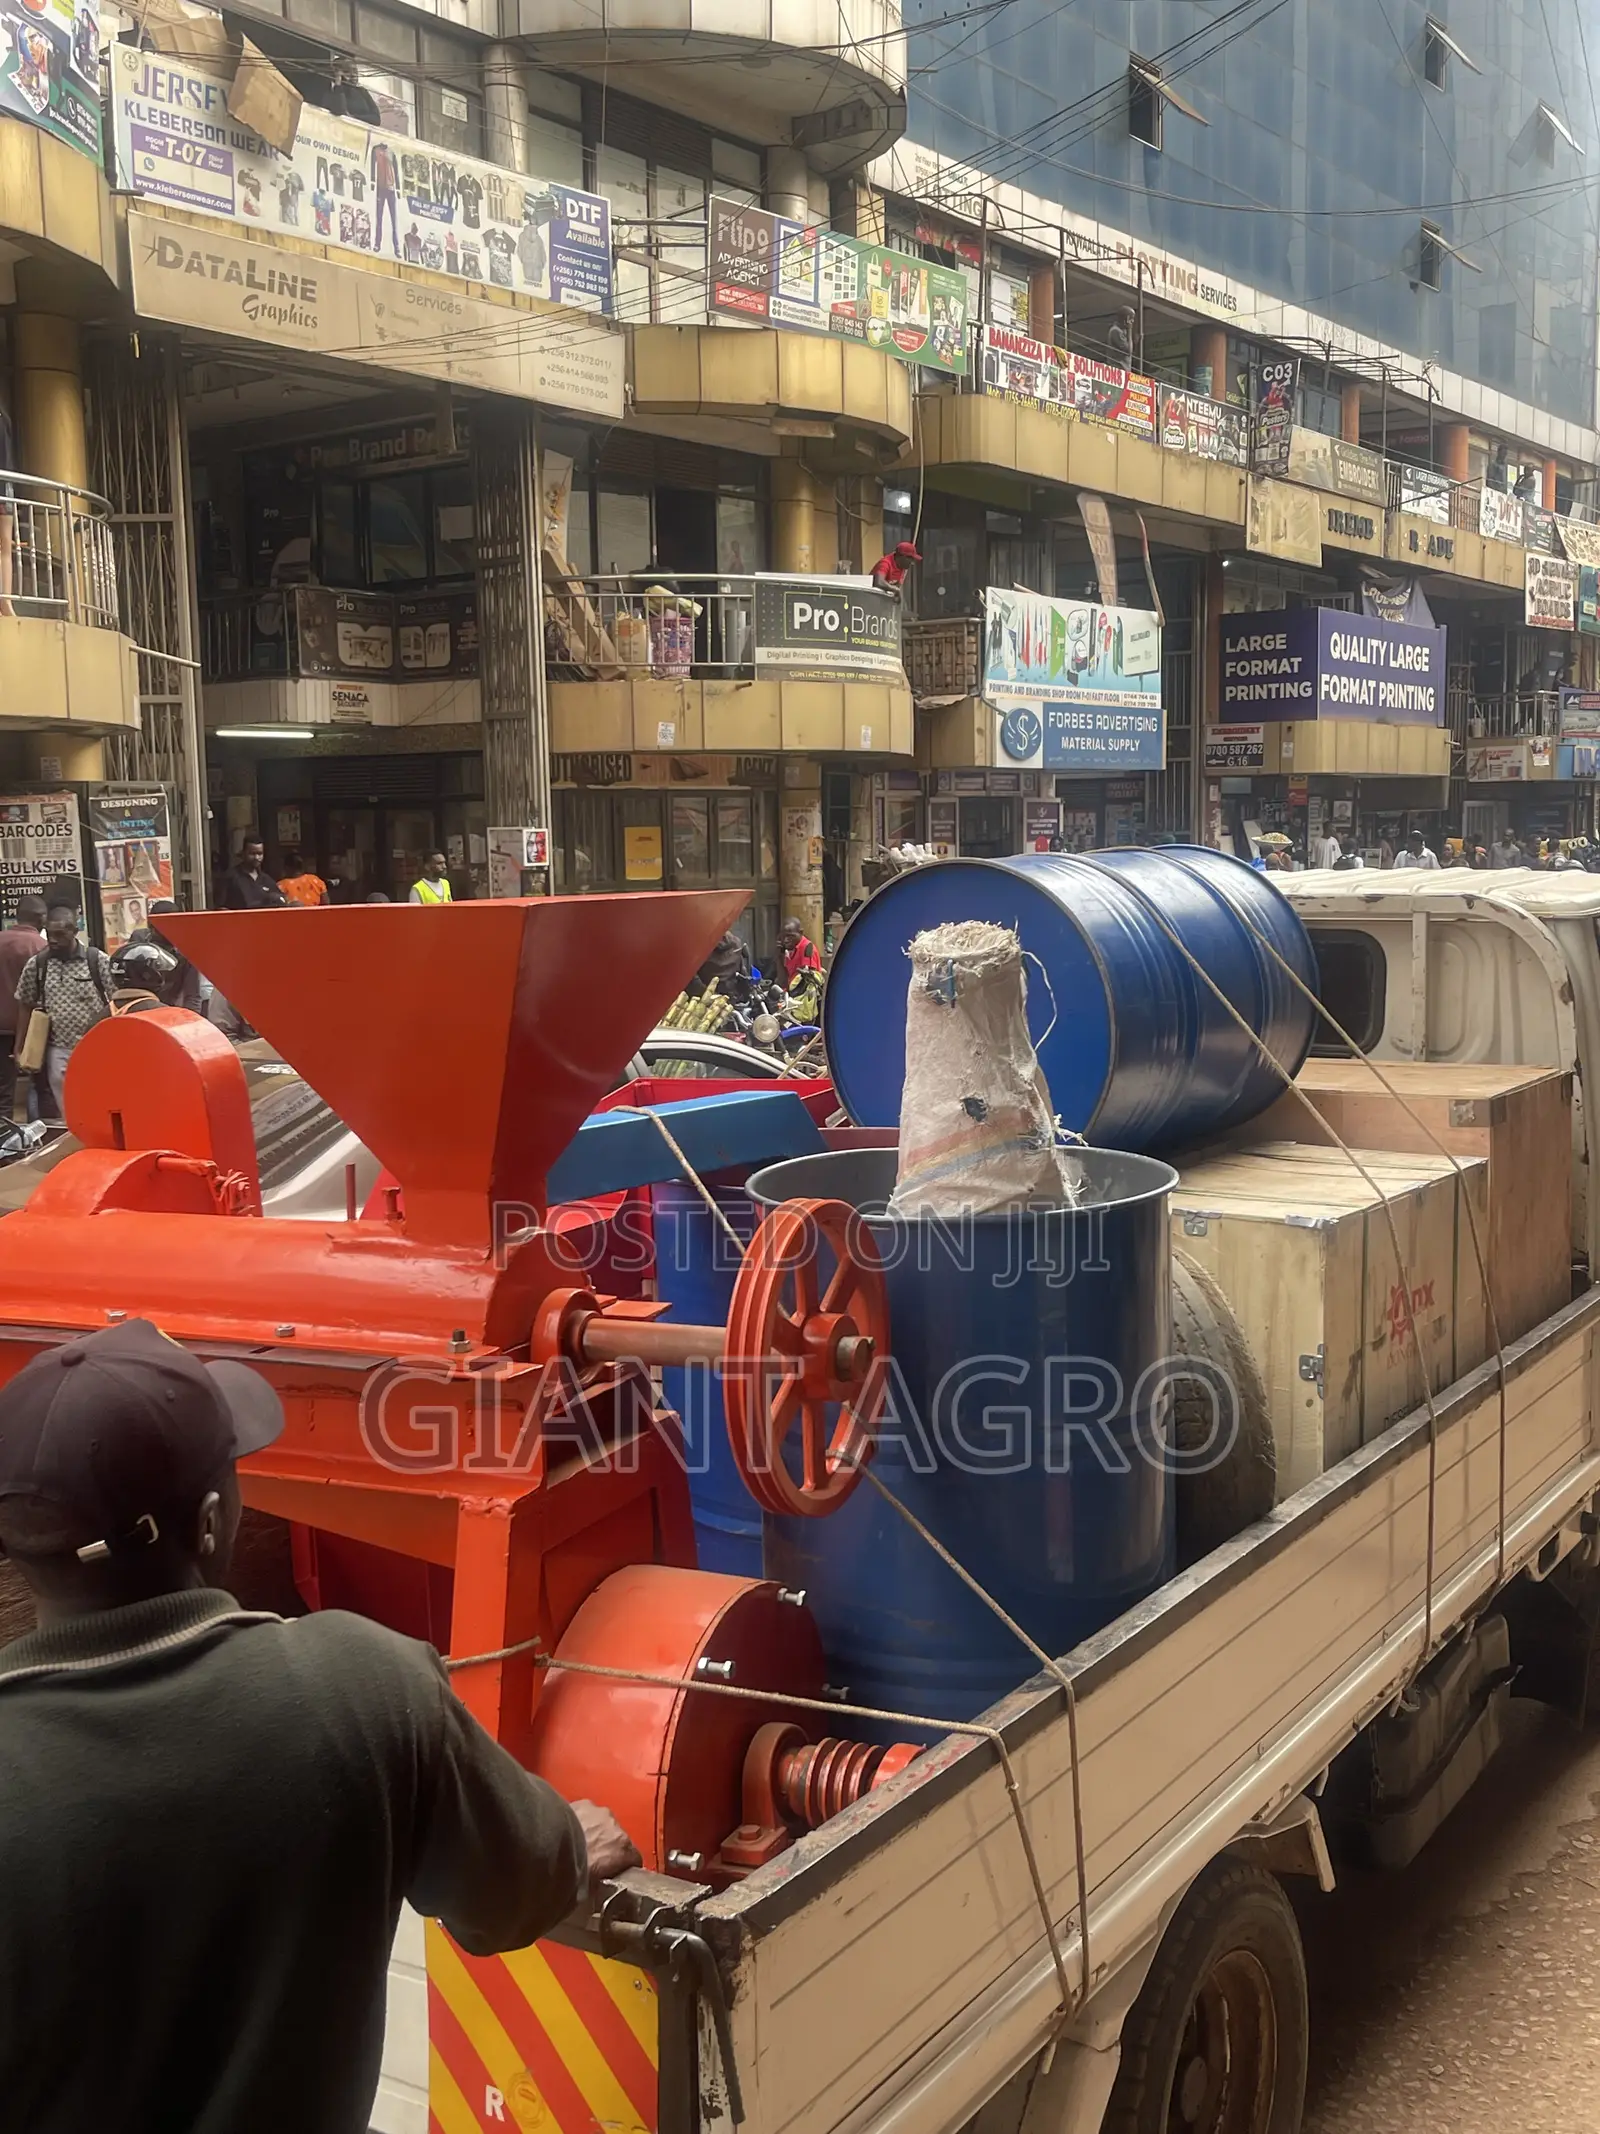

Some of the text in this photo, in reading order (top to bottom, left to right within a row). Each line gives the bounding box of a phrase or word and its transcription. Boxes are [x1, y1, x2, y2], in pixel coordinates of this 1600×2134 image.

[132, 64, 229, 116] JERSE
[124, 99, 226, 145] KLEBERSON
[231, 130, 280, 161] WEAR
[165, 137, 207, 167] T-07
[296, 134, 360, 162] OUR OWN DESIGN
[135, 178, 232, 211] www.klebersonwear.com
[565, 197, 602, 224] DTF
[565, 229, 606, 249] Available
[557, 253, 583, 267] Contact
[717, 251, 769, 275] ADVERTISING
[1115, 241, 1198, 297] PLOTTING
[1200, 284, 1237, 312] SERVICES
[241, 293, 318, 329] Graphics
[405, 288, 463, 315] Services
[1044, 345, 1071, 372] PRT
[1073, 355, 1123, 387] SOLUTIONS
[1128, 381, 1151, 394] BRANDING
[1186, 396, 1222, 420] NTEEMU
[1261, 414, 1288, 426] Posters
[349, 430, 407, 462] Brand
[1165, 434, 1184, 446] Posters
[1339, 460, 1379, 490] EMBROIDERY
[336, 598, 354, 611] Pro
[400, 604, 416, 615] Pro
[793, 602, 898, 640] Pro Brands
[1225, 633, 1287, 653] LARGE
[1330, 631, 1430, 672] QUALITY LARGE
[767, 651, 791, 661] Digital
[792, 652, 820, 661] Printing
[825, 653, 849, 663] Graphics
[1225, 657, 1302, 678] FORMAT
[332, 690, 369, 702] SENACA
[988, 683, 1013, 695] PRINTING
[1014, 685, 1025, 696] AND
[1025, 686, 1051, 698] BRANDING
[1051, 688, 1066, 698] SHOP
[1225, 681, 1313, 702] PRINTING
[1320, 674, 1435, 712] FORMAT PRINTING
[1048, 711, 1158, 732] FORBES ADVERTISING
[1061, 736, 1141, 752] MATERIAL SUPPLY
[1229, 744, 1246, 755] 587
[1246, 744, 1264, 755] 262
[101, 798, 158, 809] DESIGNING
[0, 859, 77, 875] BULKSMS
[5, 875, 57, 885] STATIONERY
[7, 886, 44, 895] CUTTING
[485, 2084, 505, 2123] R
